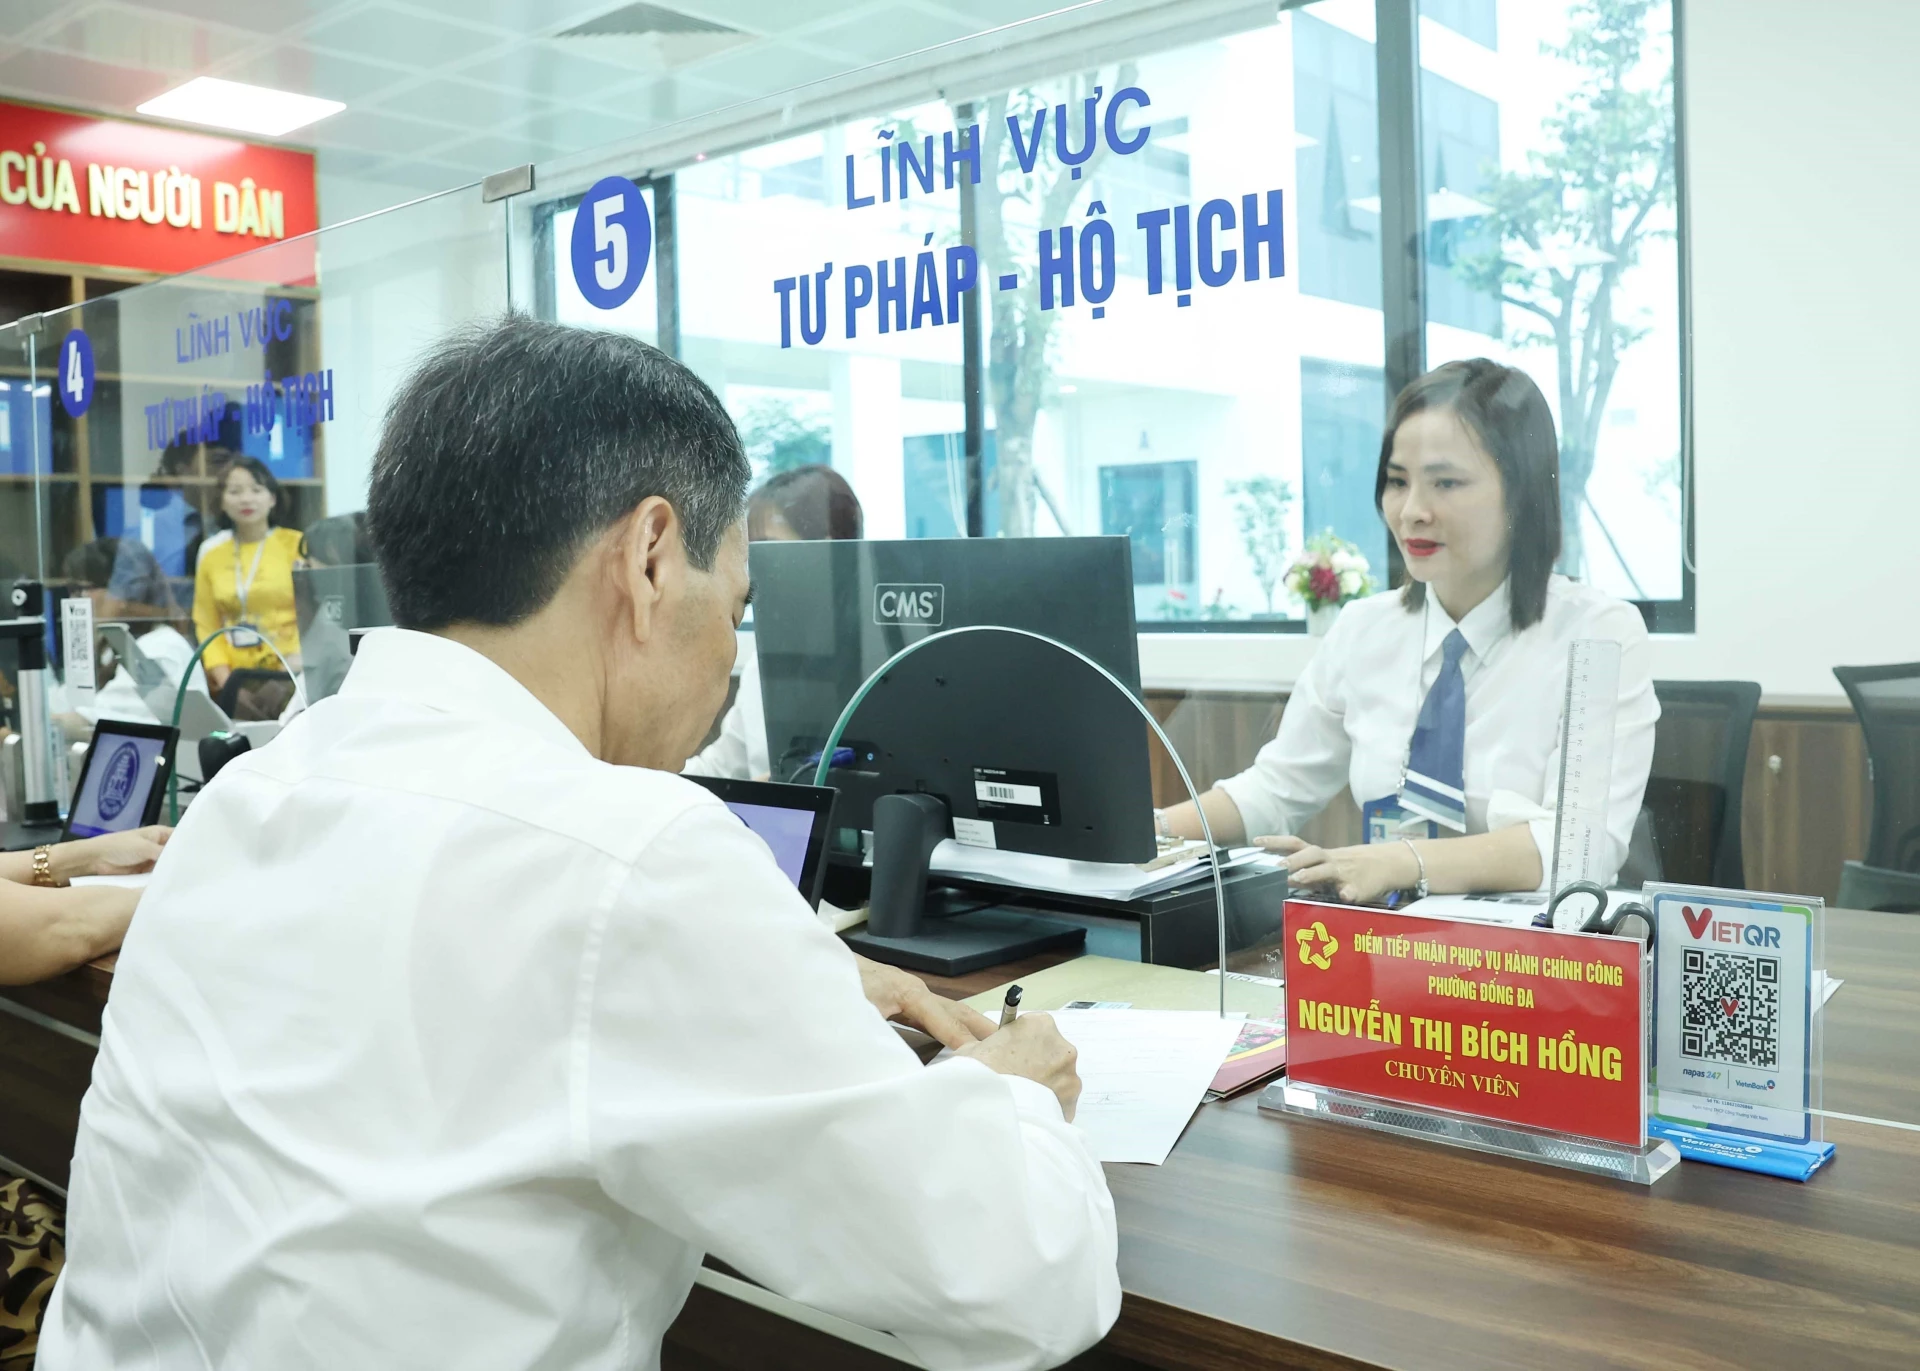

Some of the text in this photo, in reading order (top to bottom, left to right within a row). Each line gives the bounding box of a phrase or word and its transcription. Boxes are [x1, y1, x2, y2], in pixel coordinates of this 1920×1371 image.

[846, 86, 1152, 210] LĨNH VỰC
[0, 142, 285, 239] CỦA NGƯỜI DÂN
[593, 194, 629, 291] 5
[774, 188, 1285, 349] TƯ PHÁP - HỘ TỊCH
[176, 297, 293, 364] LĨNH VỰC
[67, 341, 84, 402] 4
[145, 396, 169, 451] TƯ
[172, 384, 226, 448] PHÁP
[247, 371, 276, 441] HỘ
[281, 369, 334, 435] TỊCH
[879, 591, 934, 618] CMS
[1682, 906, 1780, 948] VIETQR
[1354, 928, 1623, 987] ĐIỂM TIẾP NHẬN PHỤC VỤ HÀNH CHÍNH CÔNG
[1428, 974, 1535, 1009] PHƯỜNG ĐỐNG ĐA
[1299, 998, 1622, 1081] NGUYỄN THỊ BÍCH HỒNG
[1385, 1060, 1520, 1098] CHUYÊN VIÊN
[1682, 1068, 1721, 1080] napas 247
[1735, 1079, 1767, 1091] VietinBank
[1682, 1137, 1744, 1153] VietinBank
